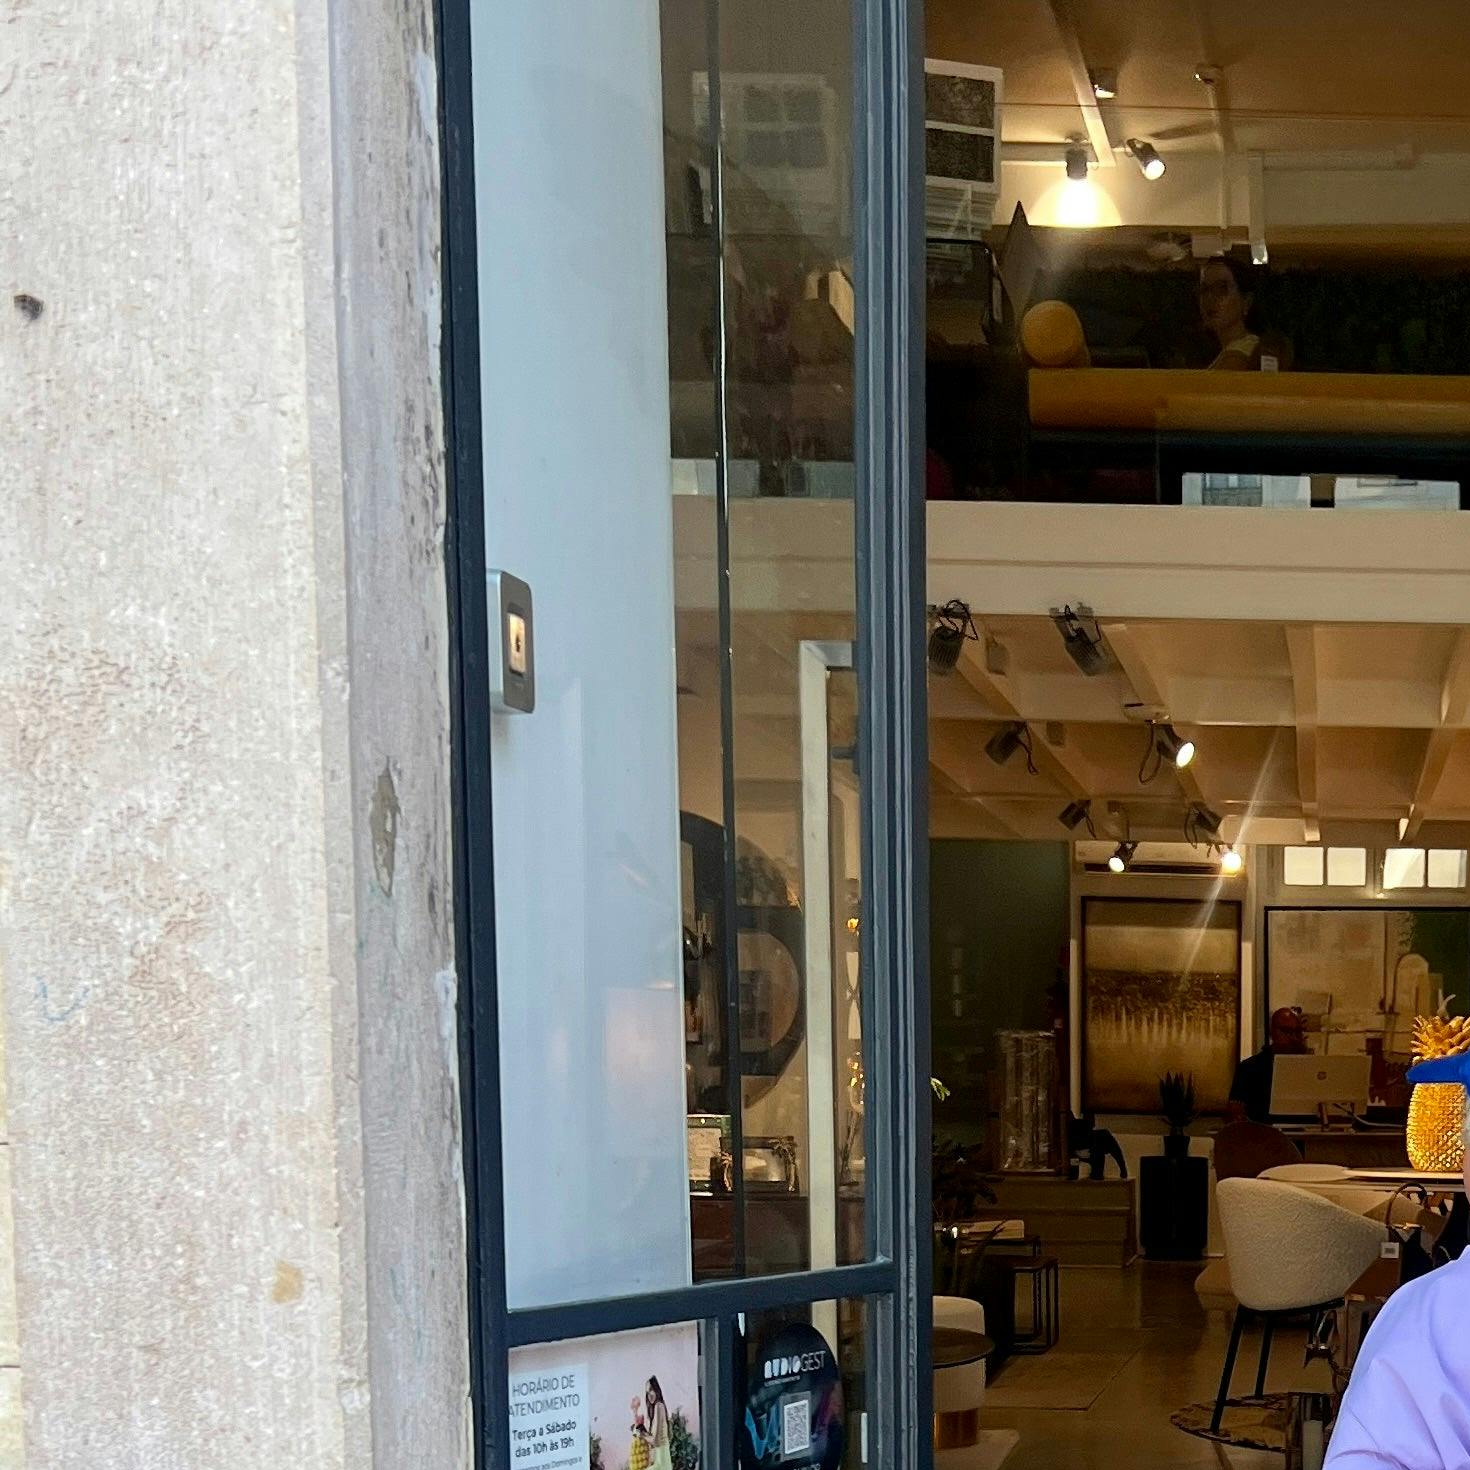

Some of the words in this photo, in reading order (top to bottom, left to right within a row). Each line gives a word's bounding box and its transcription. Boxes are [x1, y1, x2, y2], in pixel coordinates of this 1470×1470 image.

[764, 1350, 826, 1379] AUDIOGEST
[512, 1376, 559, 1398] HORÁRIO
[561, 1374, 575, 1390] DE
[509, 1393, 580, 1418] ATENDIMENTO
[512, 1428, 537, 1441] Terça
[539, 1428, 544, 1437] a
[545, 1420, 577, 1435] Sábado
[515, 1445, 531, 1458] das
[533, 1442, 548, 1454] 10h
[561, 1437, 575, 1449] 19h
